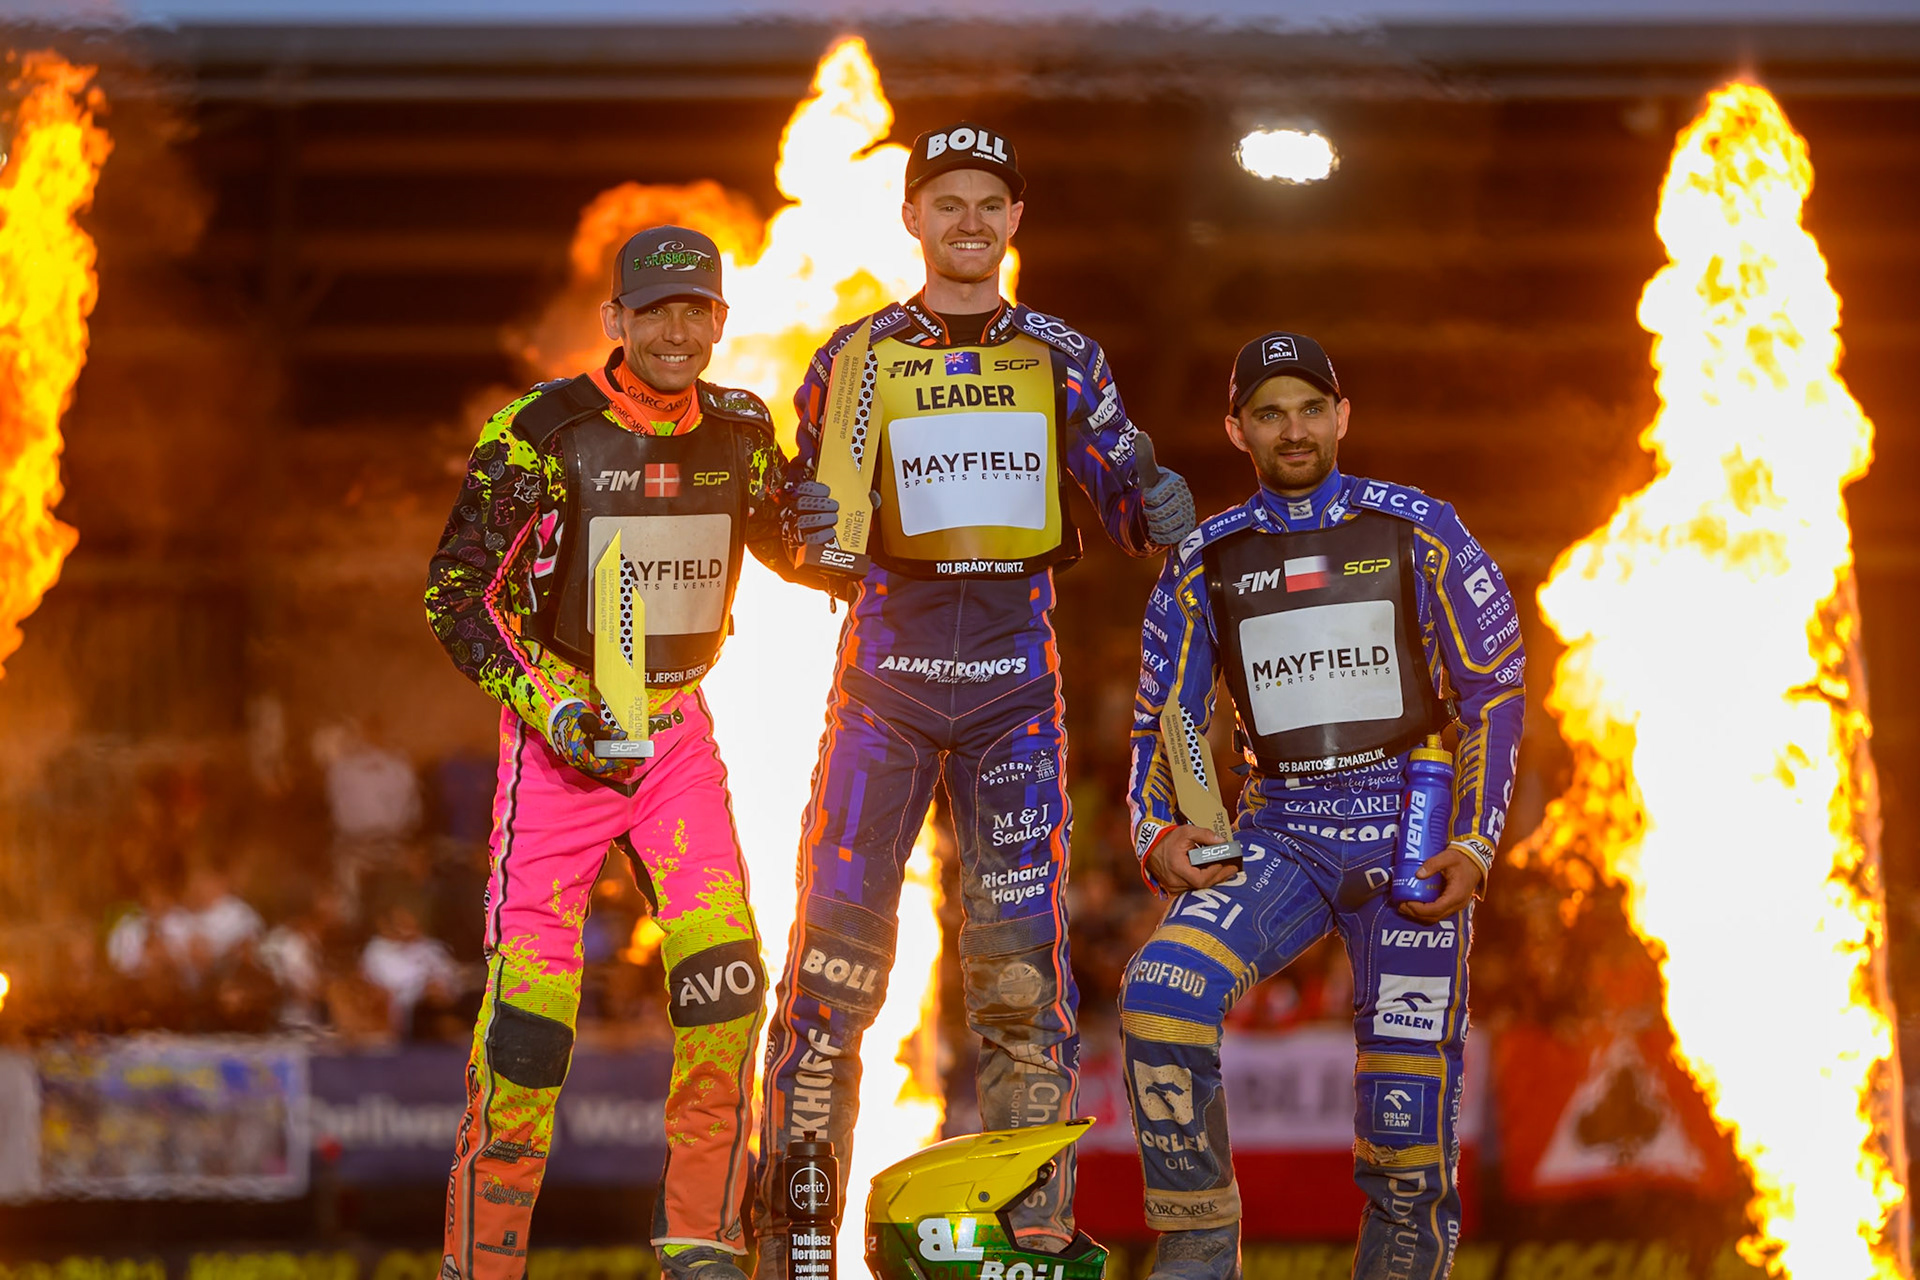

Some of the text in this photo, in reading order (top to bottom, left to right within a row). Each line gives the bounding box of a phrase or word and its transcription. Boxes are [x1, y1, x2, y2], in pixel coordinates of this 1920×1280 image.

[927, 128, 1008, 161] BOLL
[1040, 330, 1080, 357] biznesu
[1268, 351, 1292, 359] ORLEN
[840, 355, 850, 385] SPEEDWAY
[847, 356, 859, 396] MANCHESTER
[883, 358, 1040, 379] FIM SGP
[916, 383, 1017, 411] LEADER
[843, 405, 851, 418] PRIX
[840, 419, 849, 440] GRAND
[901, 452, 1041, 480] MAYFIELD
[982, 472, 1040, 483] EVENTS
[590, 470, 730, 492] FIM SGP
[1362, 485, 1430, 516] MCG
[842, 518, 853, 542] ROUND
[850, 510, 865, 549] WINNER
[1208, 511, 1247, 532] ORLEN
[820, 550, 856, 564] SGP
[936, 561, 1024, 574] 101 BRADY KURTZ
[629, 559, 723, 582] AYFIELD
[1232, 558, 1391, 596] FIM SGP
[673, 580, 721, 590] EVENTS
[1476, 591, 1513, 625] PROMET
[1480, 603, 1510, 631] CARGO
[1143, 618, 1168, 643] ORLEN
[653, 672, 683, 684] JEPSEN
[685, 664, 707, 680] JENSEN
[878, 655, 1027, 674] ARMSTRONG'S
[1252, 645, 1389, 682] MAYFIELD
[1329, 667, 1391, 679] EVENTS
[610, 743, 640, 752] SGP
[1279, 763, 1290, 772] 95
[1337, 747, 1386, 768] ZMARZLIK
[981, 762, 1033, 782] EASTERN
[989, 772, 1027, 786] POINT
[992, 803, 1049, 830] M & J
[1405, 790, 1426, 859] verva
[992, 822, 1052, 847] Sealey
[1201, 845, 1229, 858] SGP
[981, 861, 1050, 889] Richard
[1251, 857, 1281, 893] Logistics
[991, 882, 1045, 905] Hayes
[1380, 921, 1456, 948] verva
[802, 948, 879, 993] BOLL
[1128, 960, 1208, 998] PROFBUD
[1382, 1013, 1434, 1032] ORLEN
[790, 1028, 842, 1142] KHOFF
[1010, 1082, 1026, 1128] Floorin
[1383, 1112, 1411, 1121] ORLEN
[1383, 1119, 1410, 1128] TEAM
[1141, 1130, 1209, 1153] ORLEN
[1165, 1157, 1195, 1171] OIL
[795, 1181, 825, 1199] petit
[1145, 1199, 1218, 1217] GARCAREK
[792, 1233, 832, 1246] Tobiasz
[791, 1248, 832, 1260] Herman
[795, 1263, 830, 1273] żywienie
